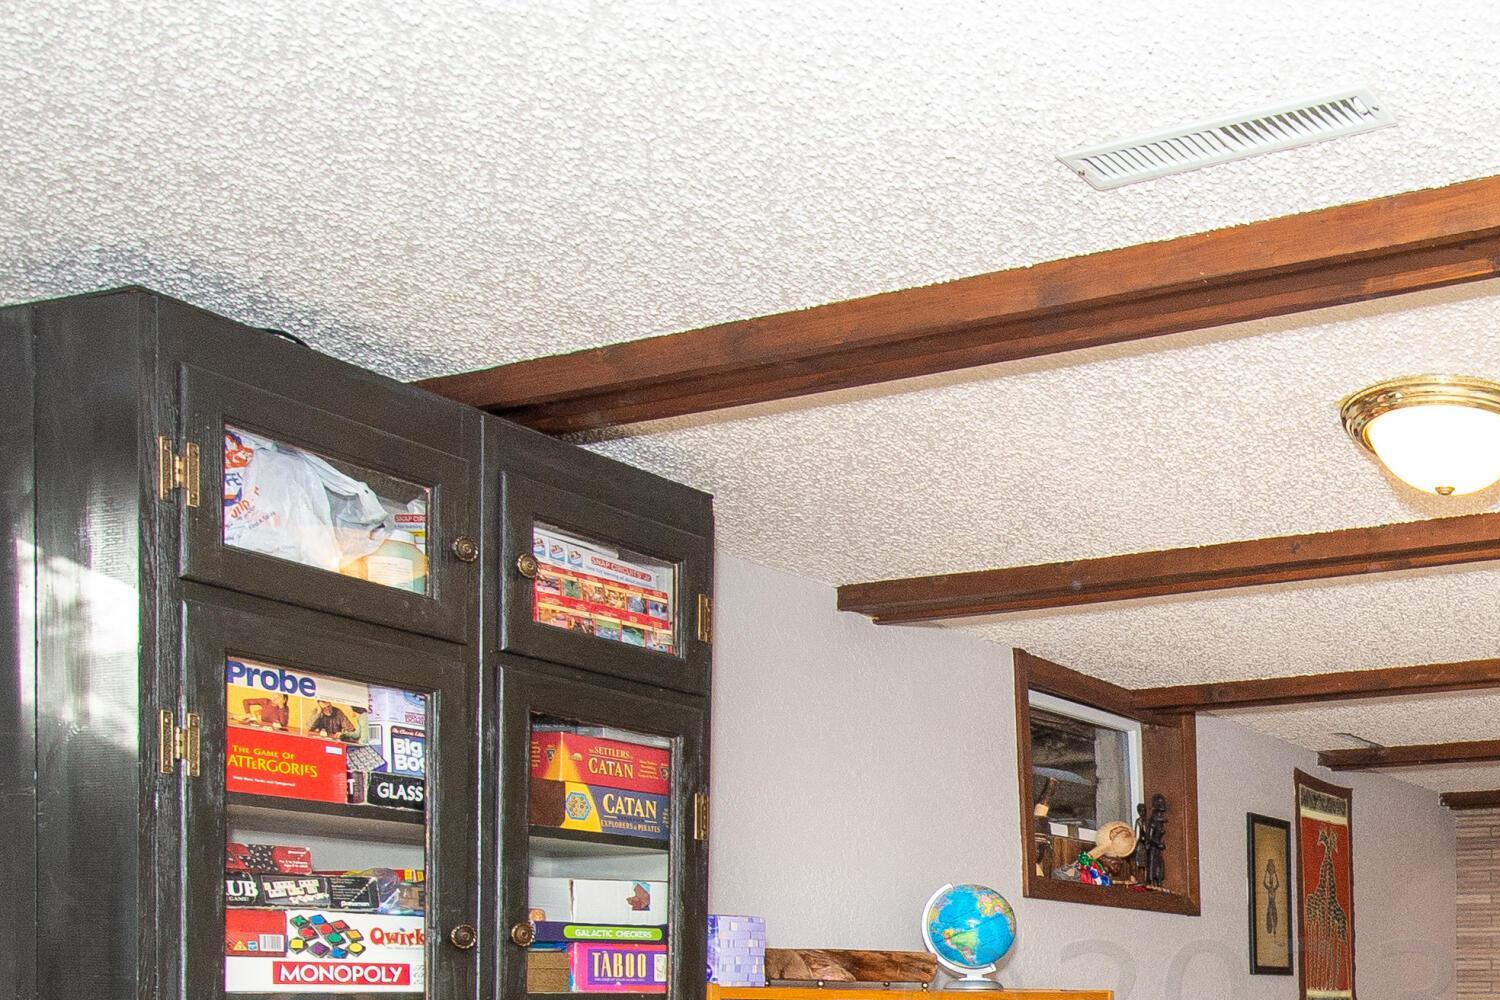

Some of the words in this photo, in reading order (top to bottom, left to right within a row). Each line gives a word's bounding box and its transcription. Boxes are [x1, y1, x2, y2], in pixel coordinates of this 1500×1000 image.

[226, 660, 317, 697] Probe
[232, 745, 250, 754] THE
[253, 748, 278, 757] GAME
[393, 738, 423, 758] Big
[595, 746, 631, 759] SETTLERS
[588, 757, 633, 778] CATAN
[377, 782, 424, 801] GLASS
[602, 793, 657, 819] CATAN
[575, 929, 613, 937] GALACTIC
[615, 930, 652, 938] CHECKERS
[279, 965, 403, 983] MONOPOLY
[592, 952, 647, 978] TABOO
